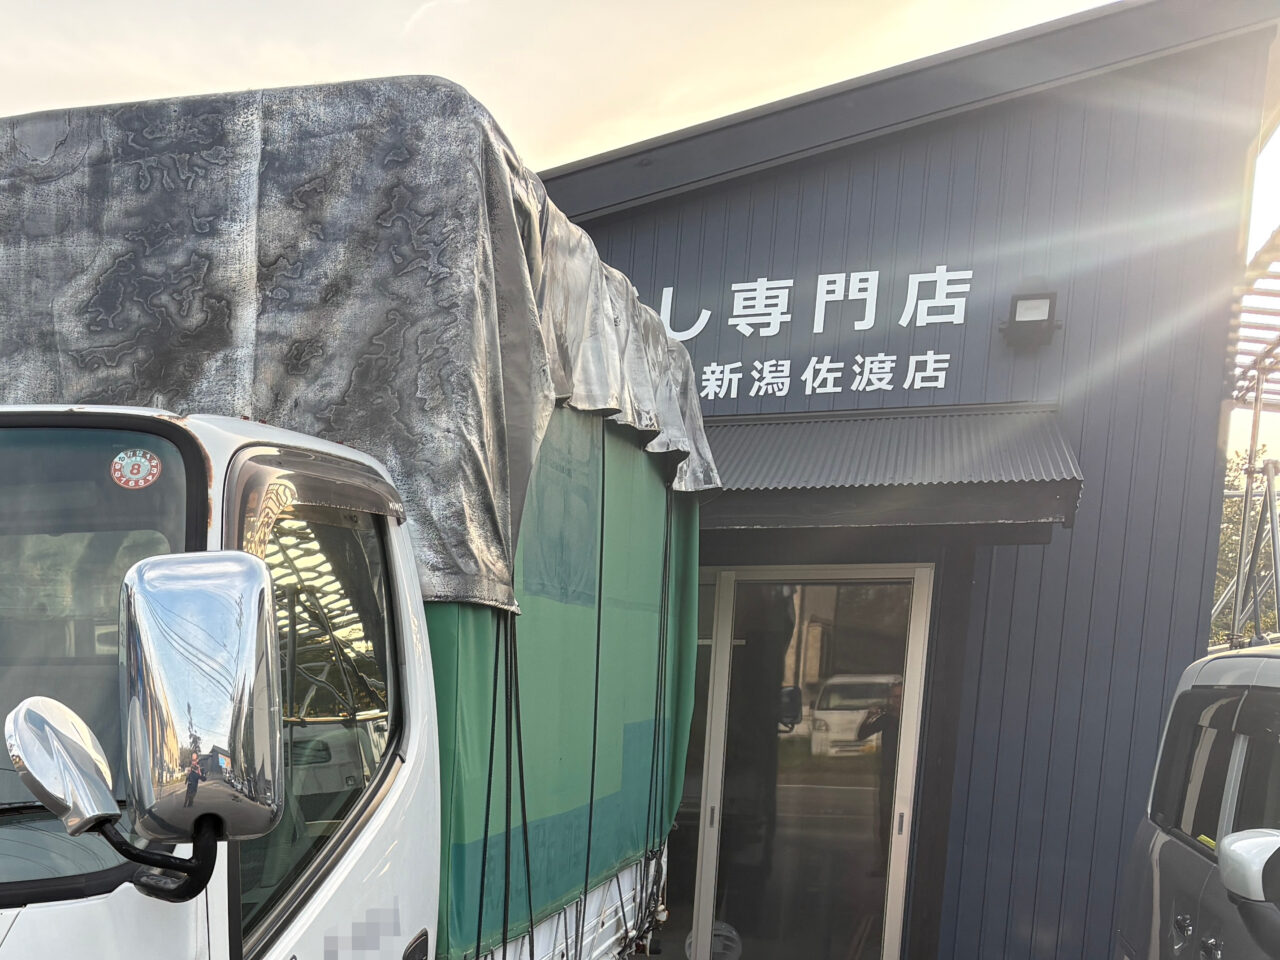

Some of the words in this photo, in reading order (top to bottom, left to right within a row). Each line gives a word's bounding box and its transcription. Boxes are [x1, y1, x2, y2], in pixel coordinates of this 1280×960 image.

[633, 265, 974, 341] し専門店
[700, 350, 951, 400] 新潟佐渡店
